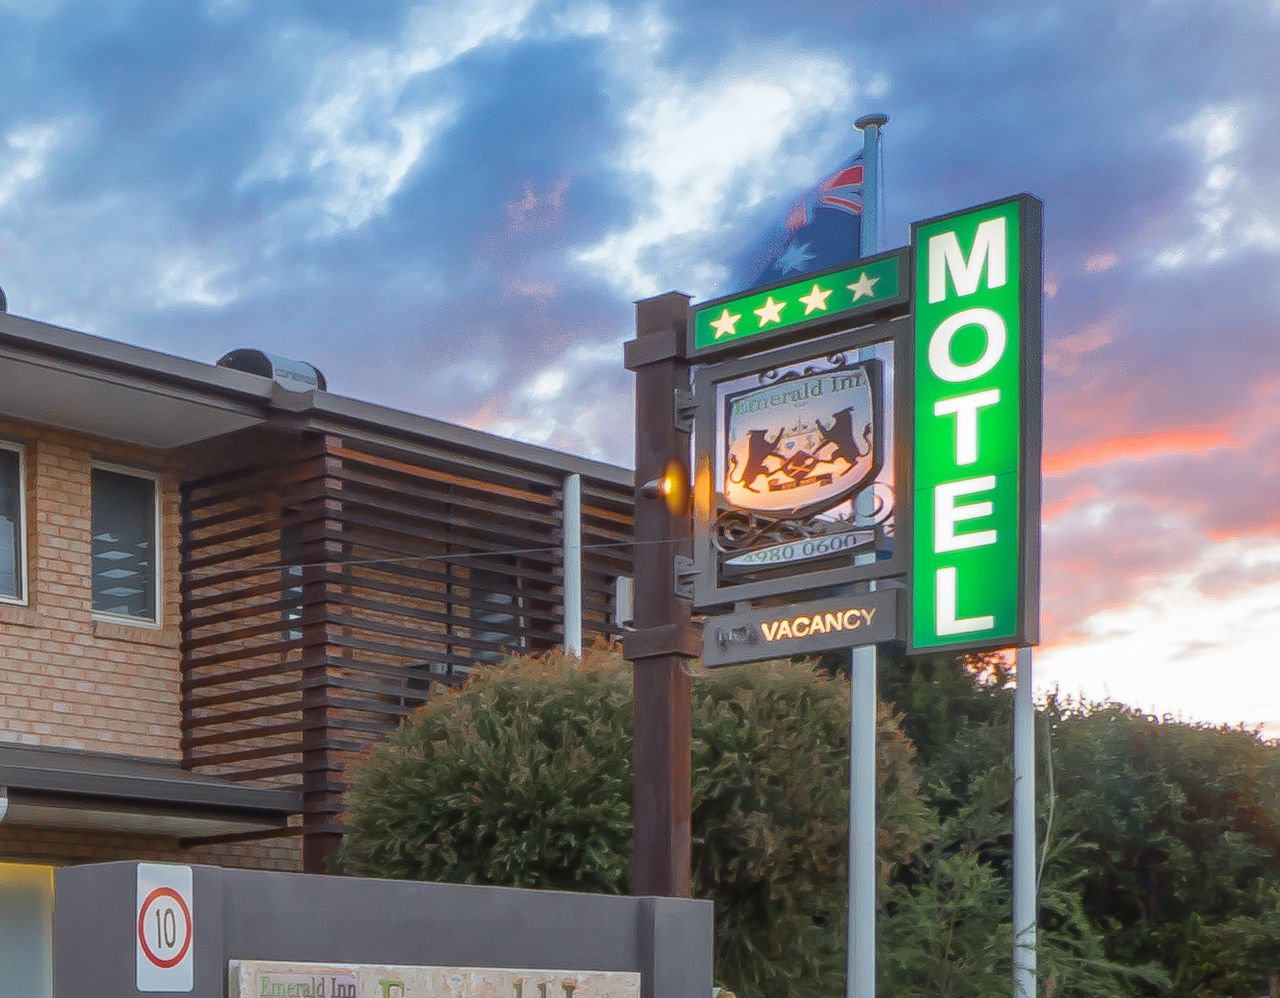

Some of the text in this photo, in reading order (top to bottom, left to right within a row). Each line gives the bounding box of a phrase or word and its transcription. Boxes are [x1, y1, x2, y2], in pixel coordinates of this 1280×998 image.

[733, 373, 867, 417] Emerald Inn
[927, 216, 1008, 637] MOTEL
[802, 533, 857, 555] 0600
[760, 608, 877, 642] VACANCY
[155, 907, 176, 949] 10
[259, 976, 357, 998] Emerald Inn
